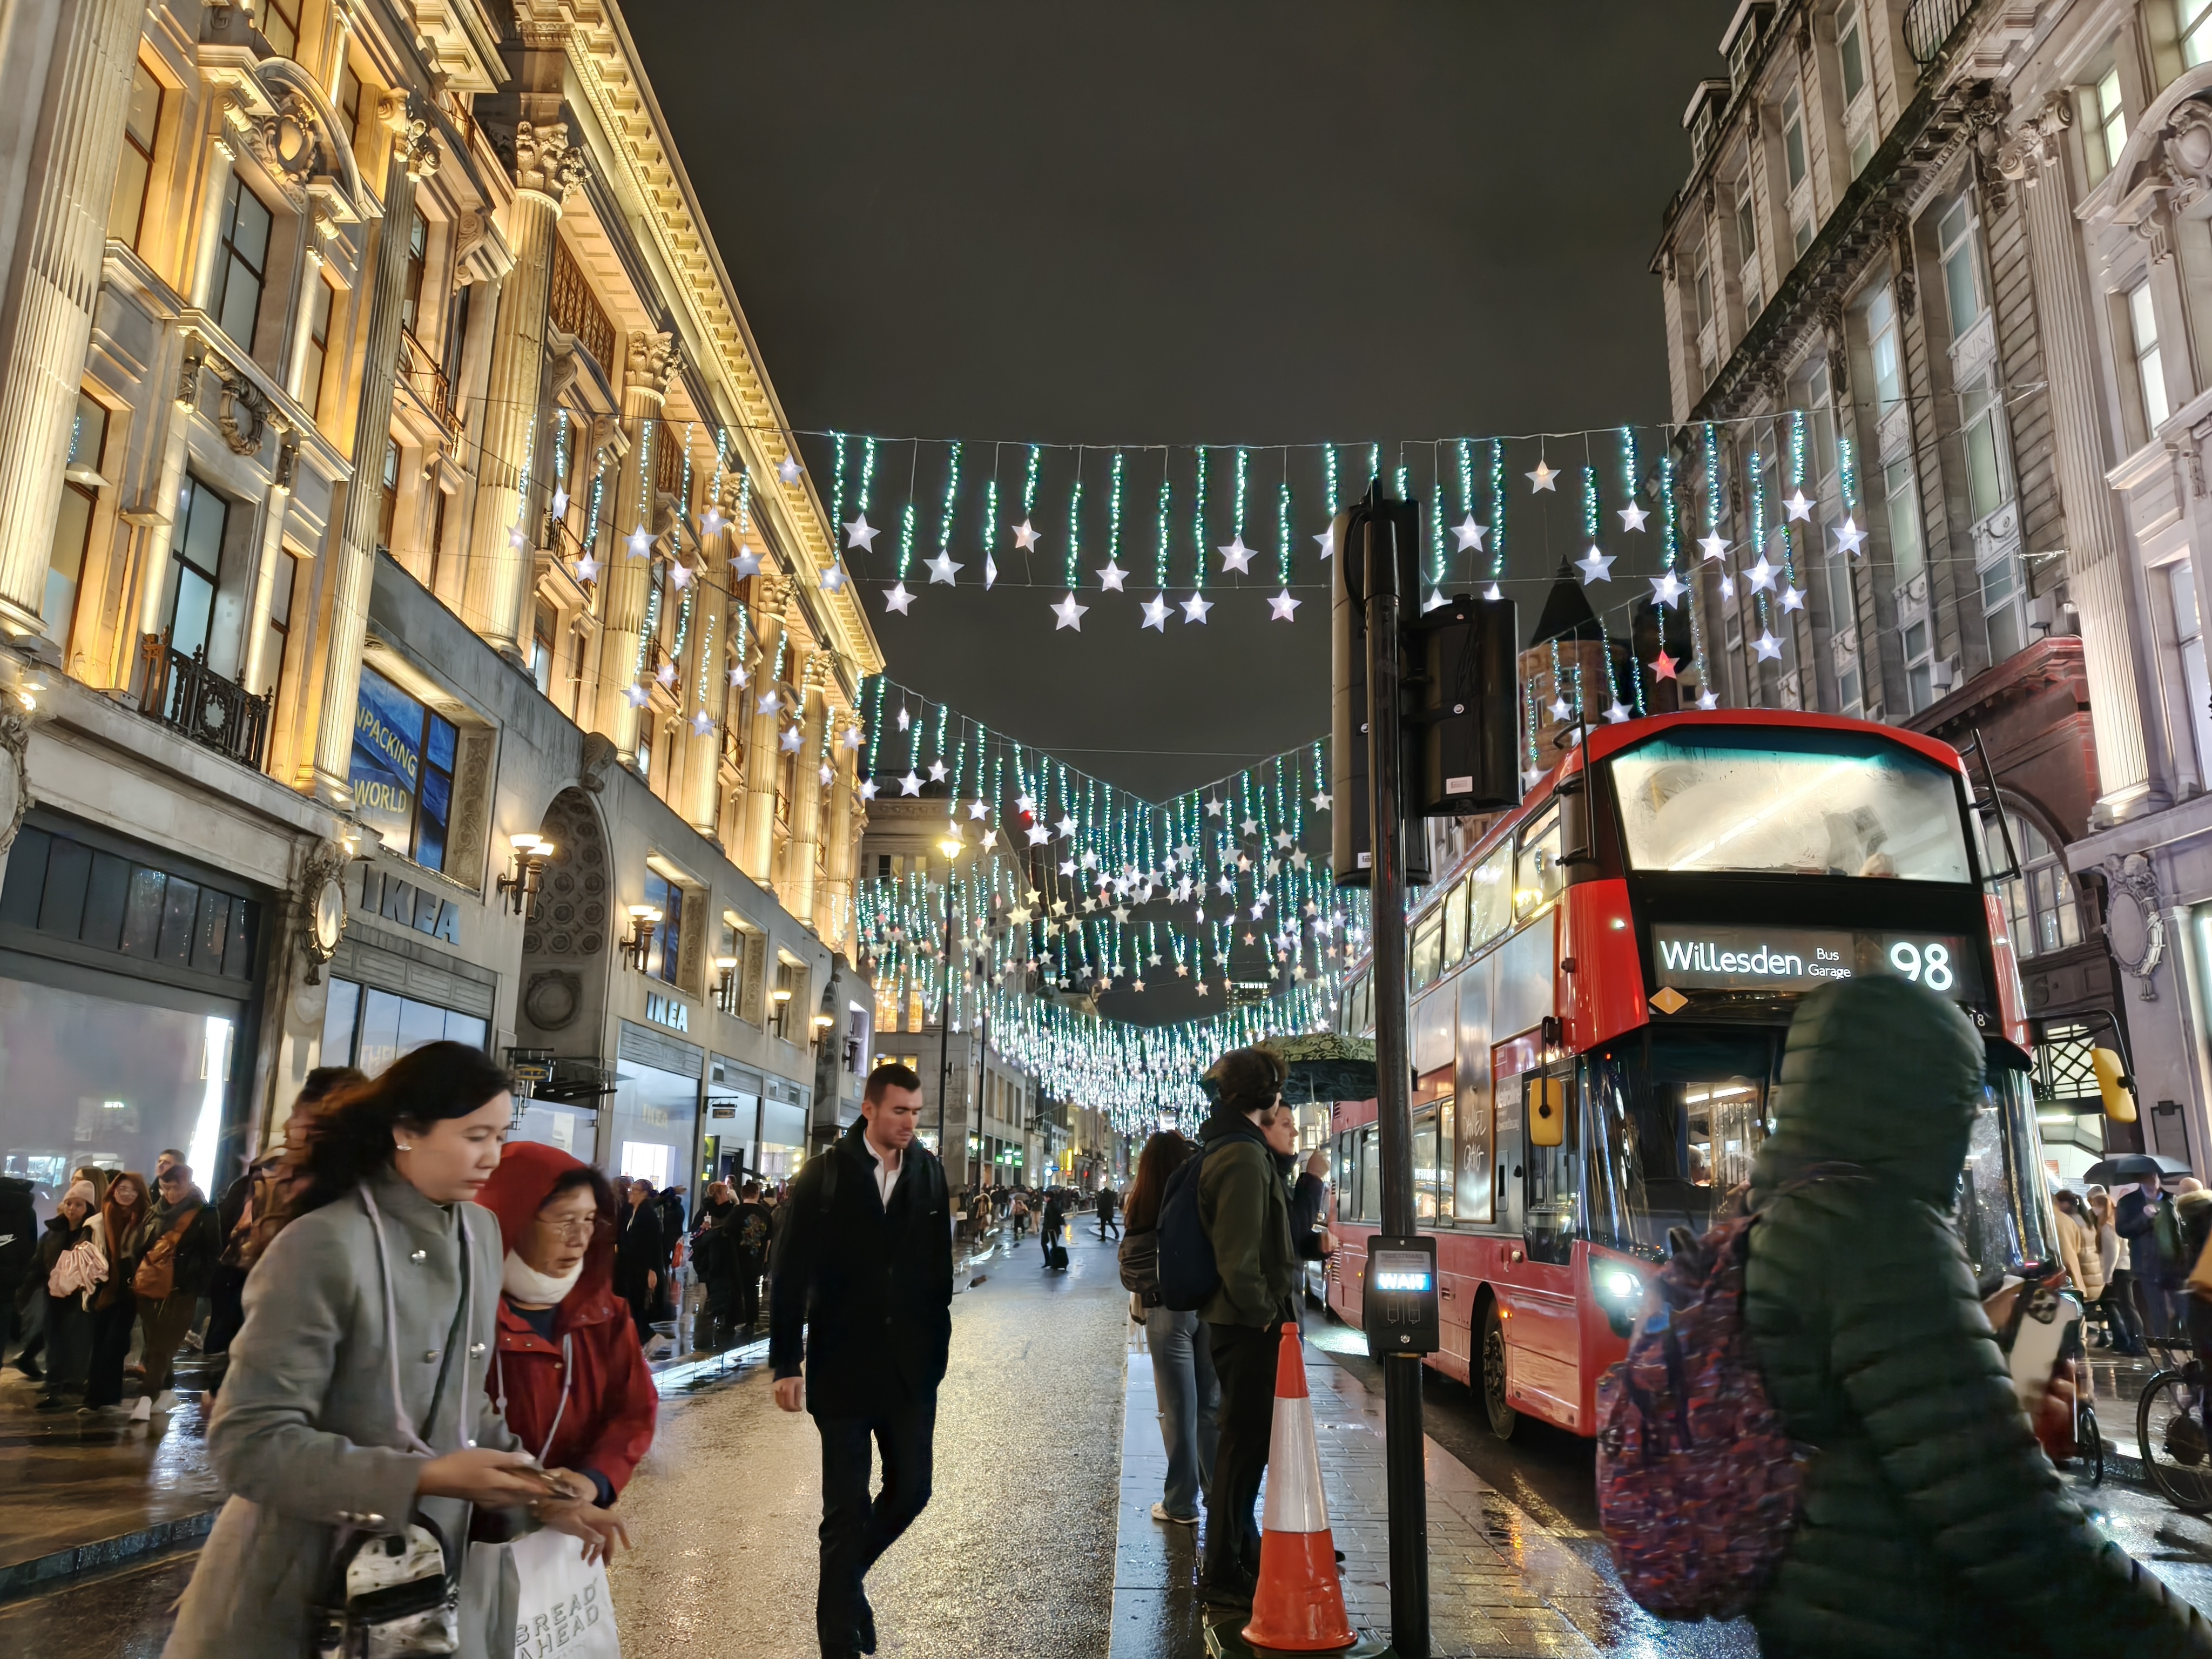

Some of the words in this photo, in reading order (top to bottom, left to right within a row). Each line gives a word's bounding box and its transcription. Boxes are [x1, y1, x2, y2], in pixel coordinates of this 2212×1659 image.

[354, 779, 407, 813] WORLD
[361, 864, 460, 946] IKEA
[1660, 940, 1803, 976] Willesden
[1808, 964, 1851, 980] Garage
[1817, 948, 1840, 961] Bus
[1890, 941, 1953, 992] 98
[646, 990, 687, 1034] IKEA
[1379, 1273, 1426, 1290] WAIT
[516, 1579, 597, 1647] BREAD
